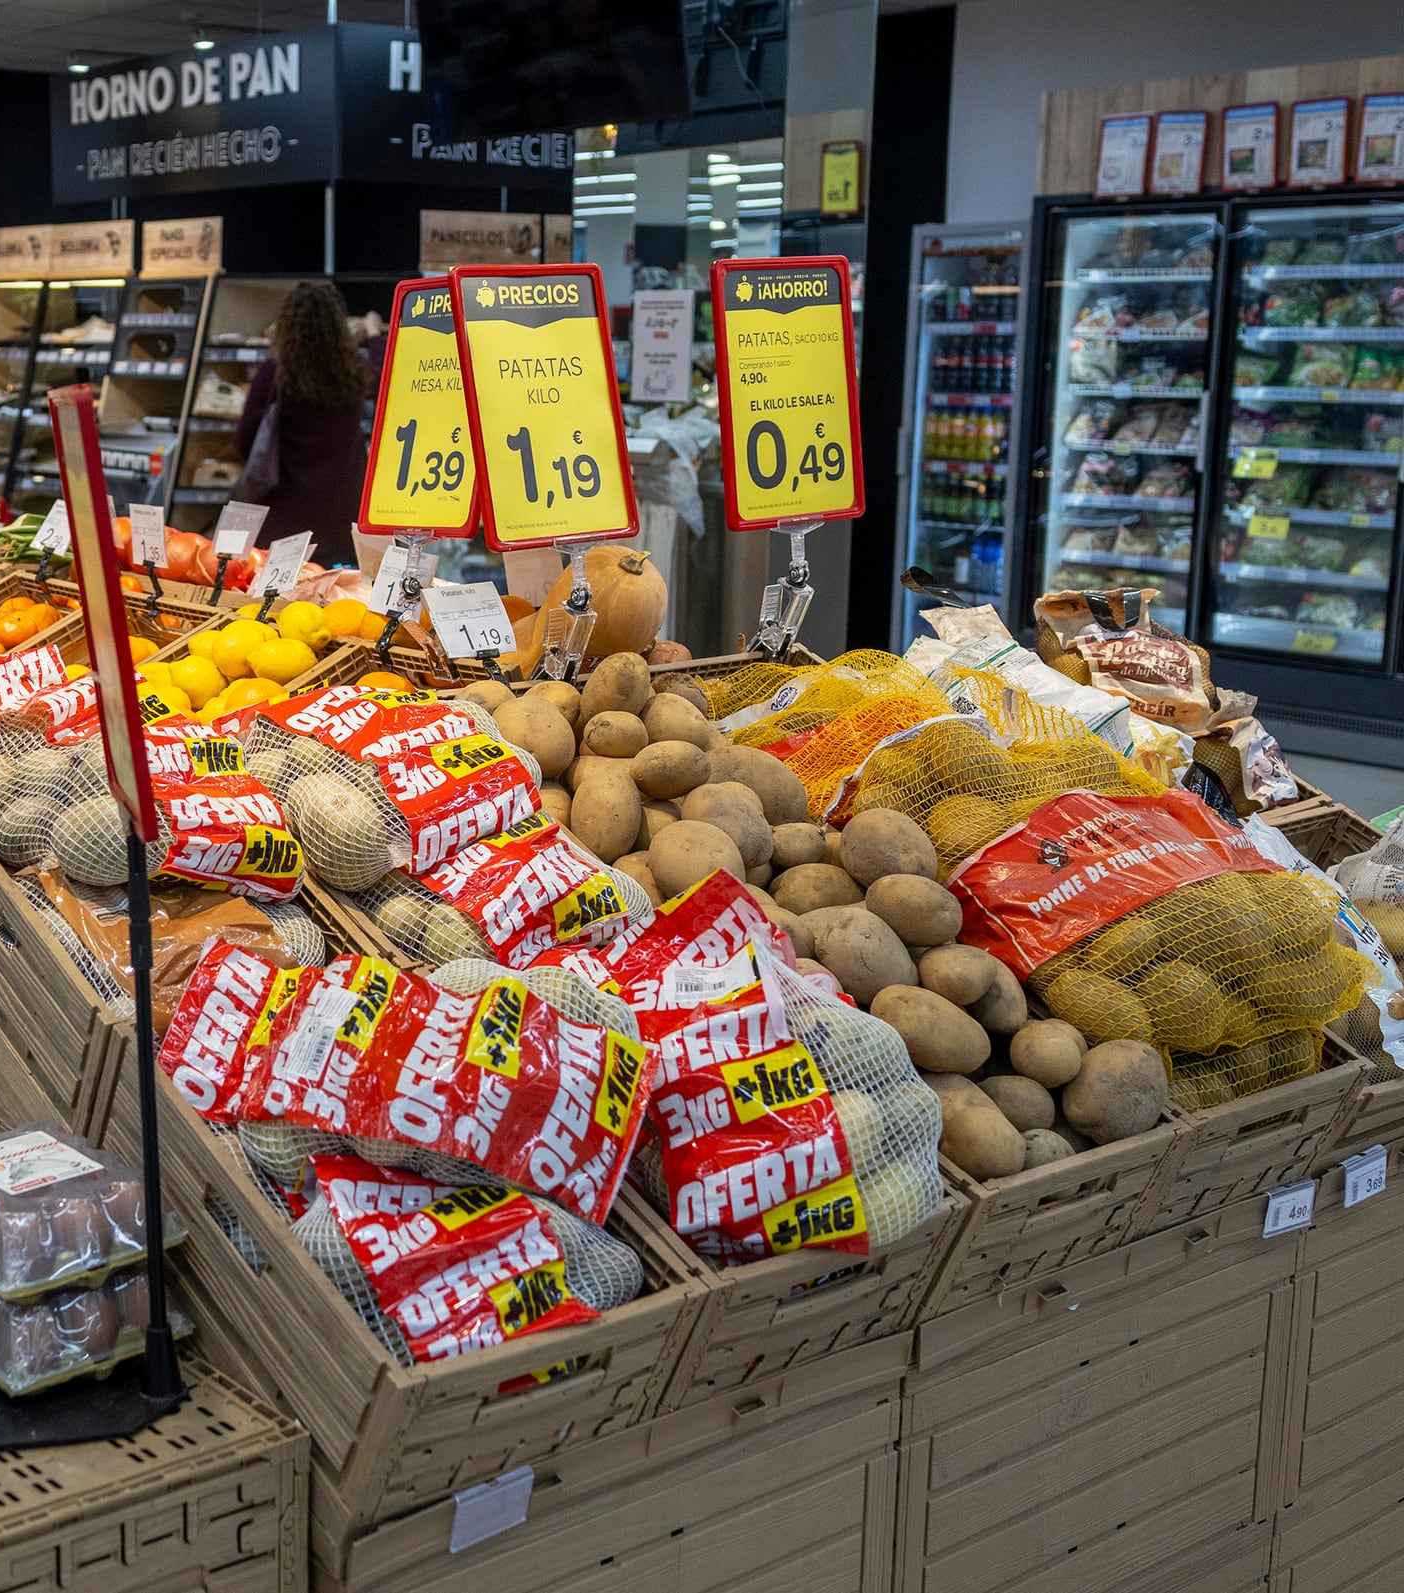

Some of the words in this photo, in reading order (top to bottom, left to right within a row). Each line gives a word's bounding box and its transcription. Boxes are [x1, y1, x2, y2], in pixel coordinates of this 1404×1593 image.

[70, 66, 175, 125] HORNO
[181, 57, 223, 108] DE
[229, 43, 299, 100] PAN
[87, 146, 127, 182] PAN
[129, 131, 200, 177] RECIÉN
[200, 125, 283, 169] HECHO
[430, 229, 505, 245] PANECILLOS
[498, 283, 580, 306] PRECIOS
[757, 279, 829, 301] ¡AHORRO!
[498, 356, 583, 380] PATATAS
[738, 331, 793, 349] PATATAS,
[795, 333, 818, 345] SACO
[818, 332, 828, 343] 10
[827, 331, 839, 342] KG
[739, 361, 773, 370] Comprando
[411, 379, 444, 393] MESA,
[526, 387, 561, 405] KILO
[750, 400, 762, 411] EL
[763, 398, 784, 410] KILO
[786, 397, 797, 408] LE
[799, 394, 824, 407] SALE
[825, 393, 835, 404] A:
[396, 418, 465, 497] 1,39
[451, 426, 461, 443] €
[506, 426, 602, 509] 1,19
[572, 430, 583, 445] €
[746, 420, 845, 492] 0,49
[815, 423, 825, 438] €
[465, 587, 476, 595] kilo
[459, 624, 502, 650] 1,19
[320, 700, 379, 744] 3KG
[189, 738, 239, 772] +1KG
[388, 761, 447, 801] 3KG
[442, 743, 505, 772] +1KG
[170, 793, 284, 830] OFERTA
[414, 782, 535, 872] OFERTA
[173, 836, 243, 874] 3KG
[245, 830, 298, 873] +1KG
[431, 843, 496, 897] 3KG
[481, 842, 597, 946] OFERTA
[1027, 873, 1089, 920] POMME
[1084, 861, 1111, 885] DE
[1106, 844, 1155, 872] TERRE
[556, 885, 621, 937] +1KG
[172, 948, 272, 1111] OFERTA
[479, 986, 523, 1069] +1KG
[302, 1043, 359, 1130] 3KG
[389, 991, 482, 1144] OFERTA
[607, 1046, 639, 1130] +1KG
[454, 1066, 513, 1160] 3KG
[529, 1016, 605, 1192] OFERTA
[657, 1086, 732, 1150] 3KG
[733, 1057, 815, 1107] +1KG
[675, 1133, 842, 1235] OFERTA
[352, 1212, 438, 1276] 3KG
[771, 1195, 855, 1247] +1KG
[397, 1216, 561, 1338] OFERTA
